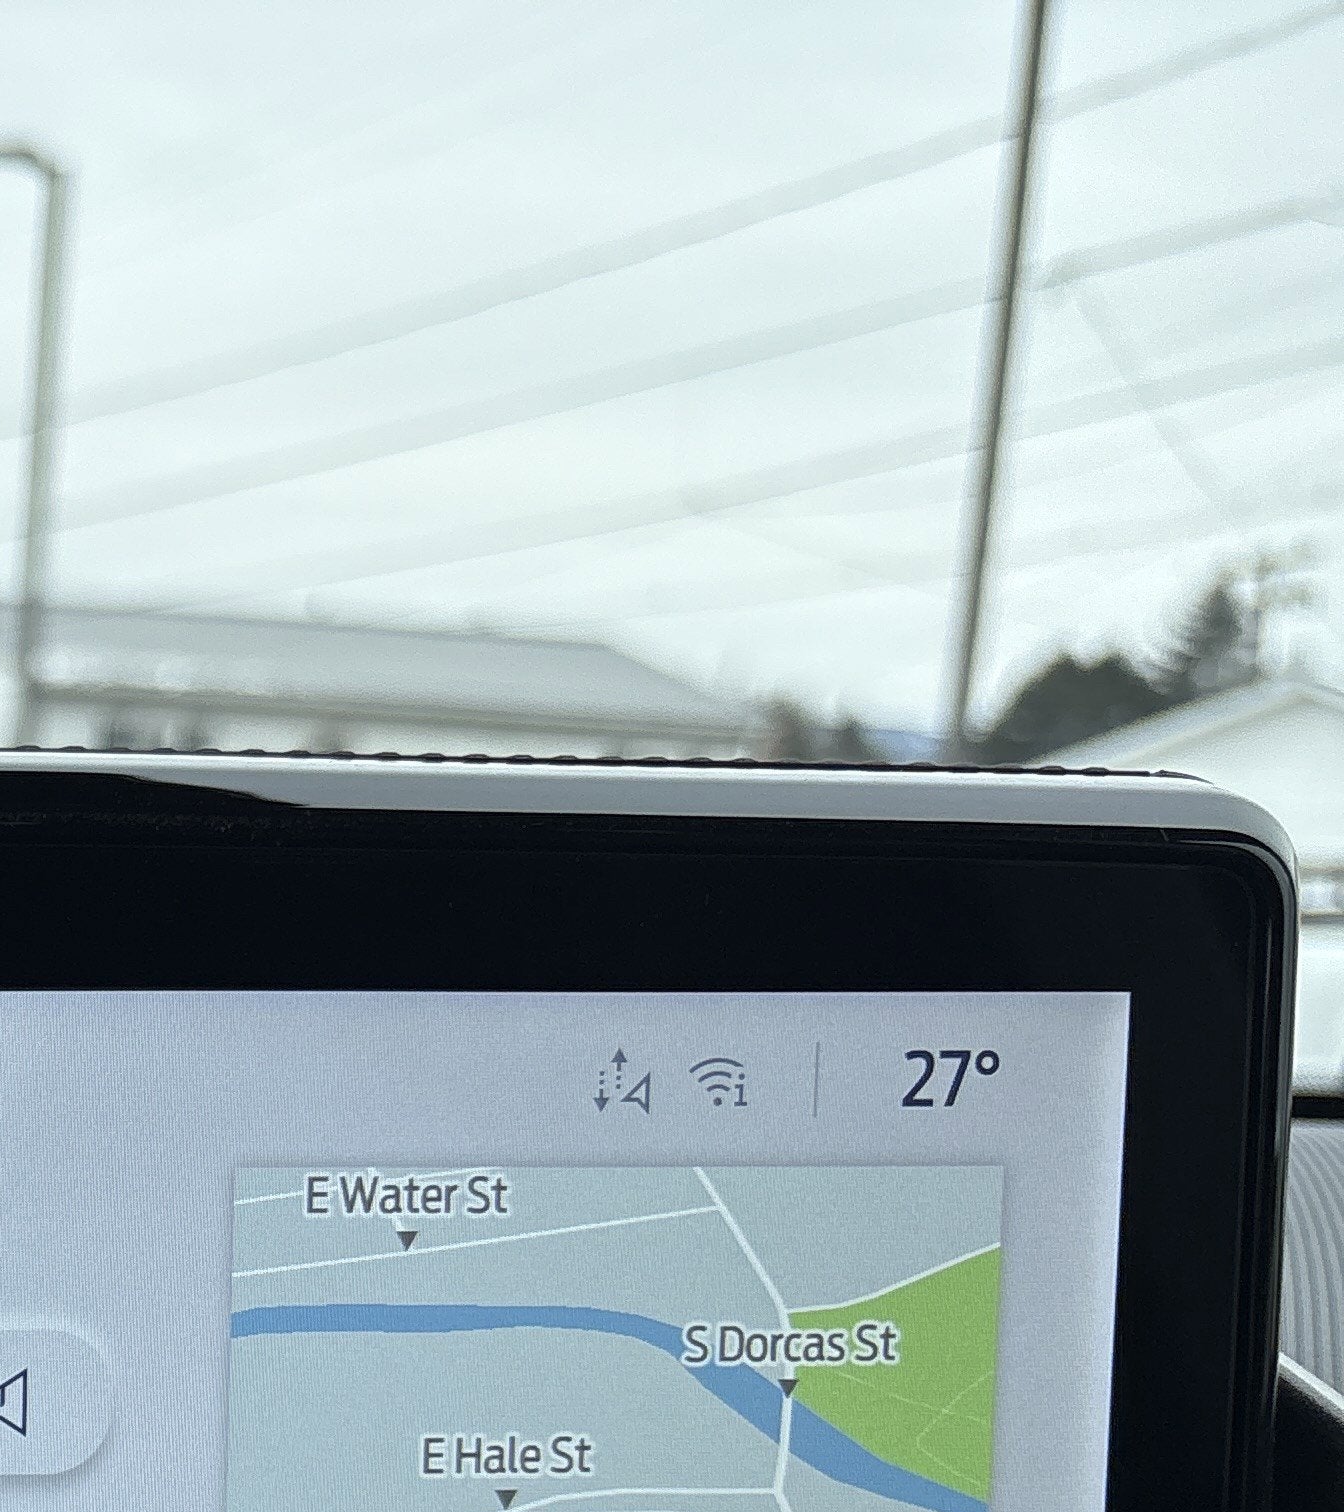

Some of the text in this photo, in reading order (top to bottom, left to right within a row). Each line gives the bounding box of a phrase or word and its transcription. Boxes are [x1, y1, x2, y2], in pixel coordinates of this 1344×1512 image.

[901, 1049, 1000, 1107] 27°
[306, 1175, 508, 1214] E Water St
[684, 1324, 897, 1363] S Dorcas St
[423, 1435, 592, 1475] E Hale St
